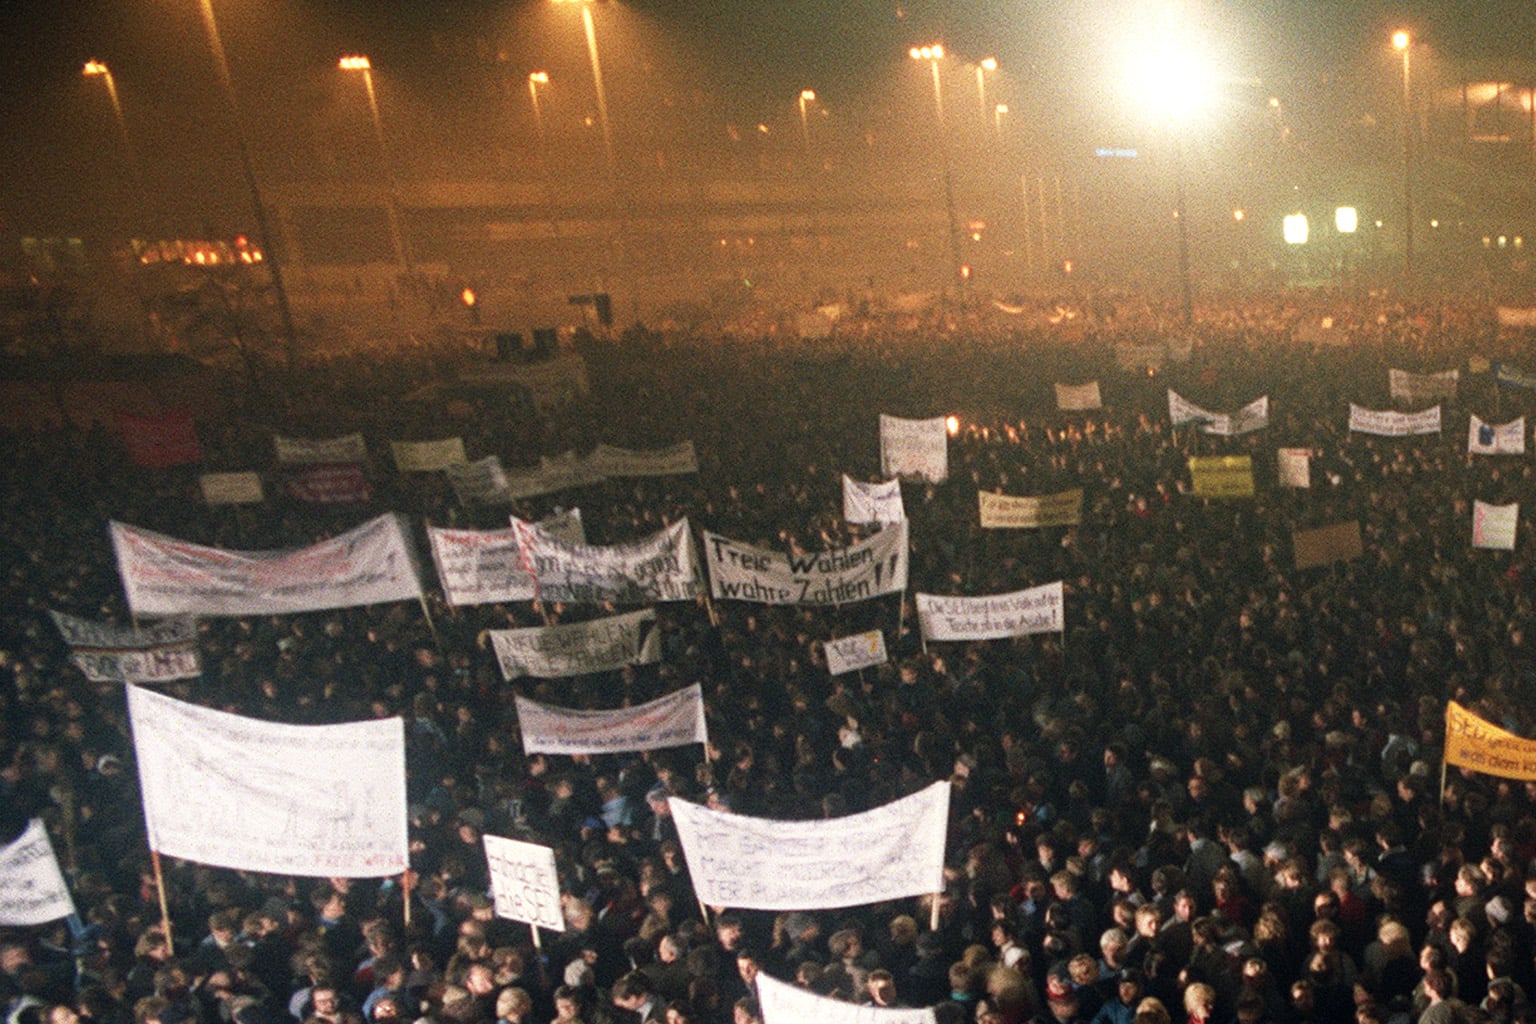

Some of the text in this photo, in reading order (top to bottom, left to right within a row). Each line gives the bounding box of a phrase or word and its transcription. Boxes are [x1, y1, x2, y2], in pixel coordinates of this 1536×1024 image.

[787, 546, 873, 575] Wahlen
[719, 575, 789, 602] wahre
[793, 577, 870, 603] Zahlen
